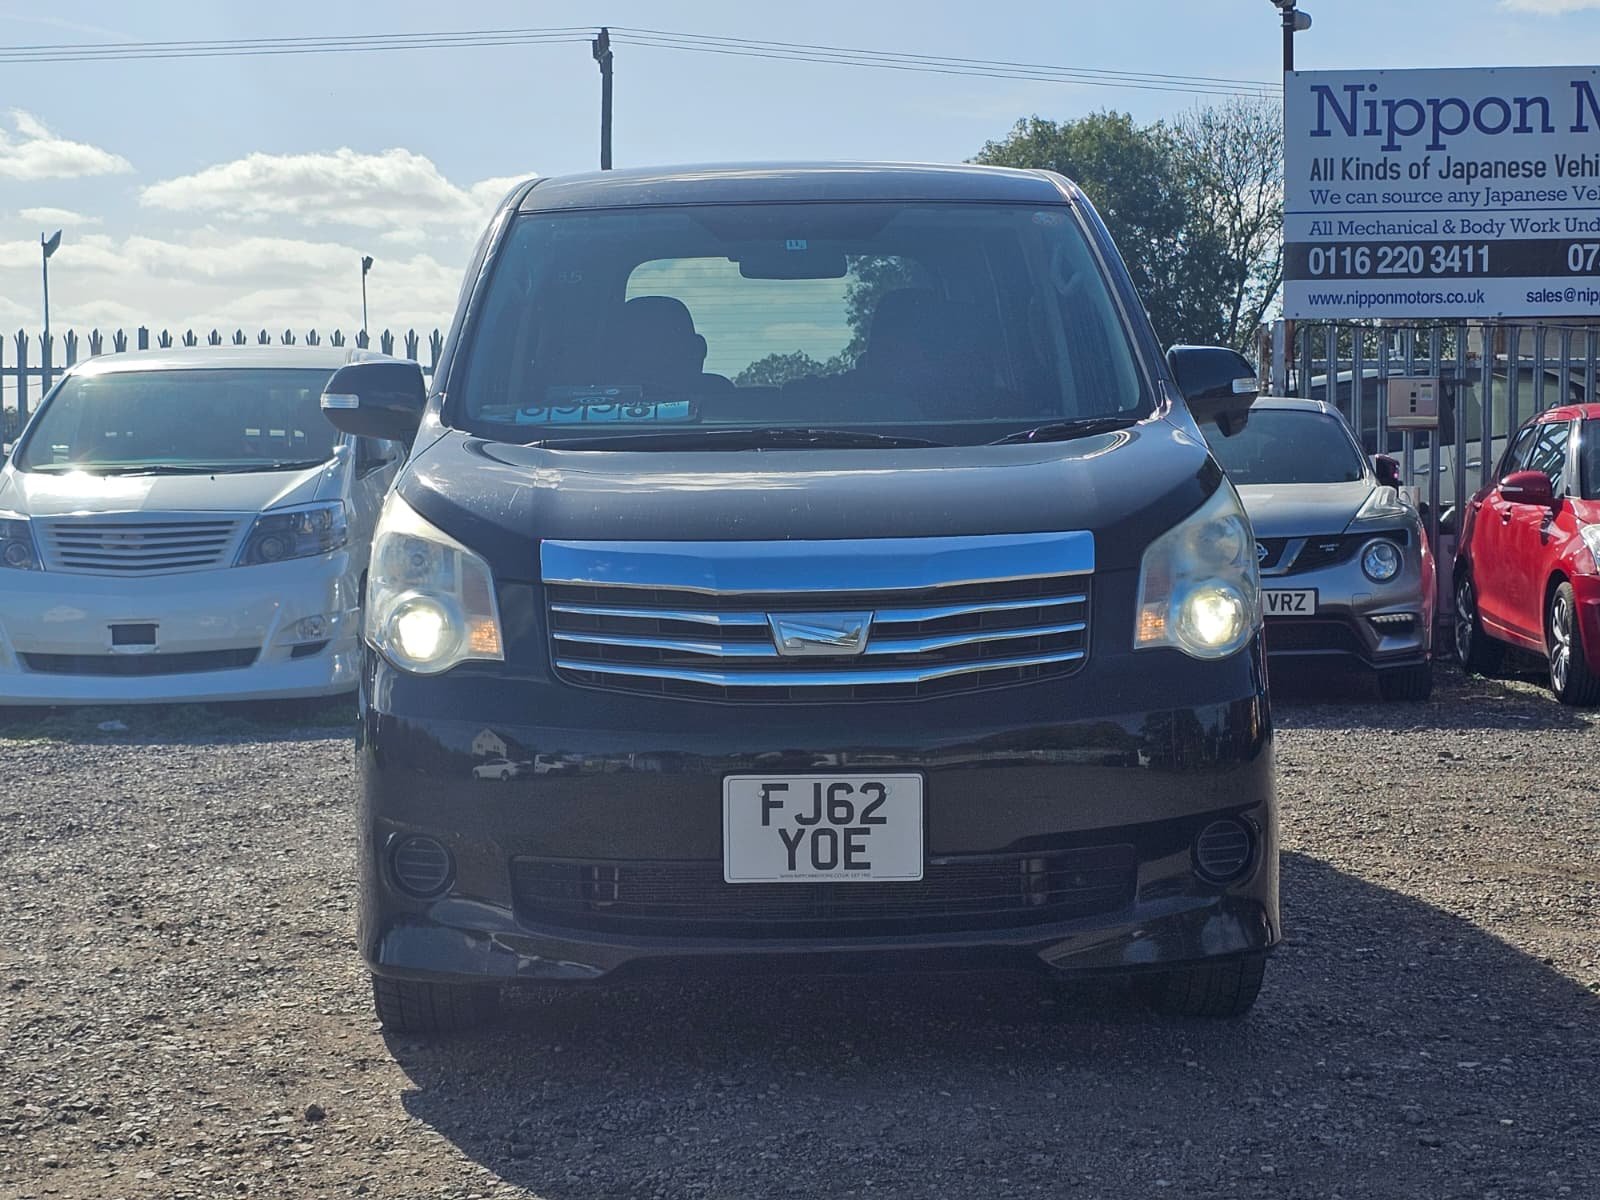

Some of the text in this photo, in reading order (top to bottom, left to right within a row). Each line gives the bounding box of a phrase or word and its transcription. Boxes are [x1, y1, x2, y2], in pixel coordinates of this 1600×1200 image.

[1309, 84, 1555, 151] Nippon
[1310, 154, 1600, 185] All Kinds of Japanese Vehi
[1309, 186, 1600, 207] We can source any Japanese Ve
[1308, 221, 1332, 236] All
[1338, 219, 1438, 235] Mechanical
[1442, 220, 1456, 234] &
[1460, 219, 1505, 237] Body
[1510, 218, 1559, 233] Work
[1308, 243, 1600, 275] 0116 220 3411 07
[1308, 287, 1600, 308] www.nipponmotors.co.uk sales@nip
[1267, 593, 1306, 611] VRZ
[778, 827, 871, 871] YOE
